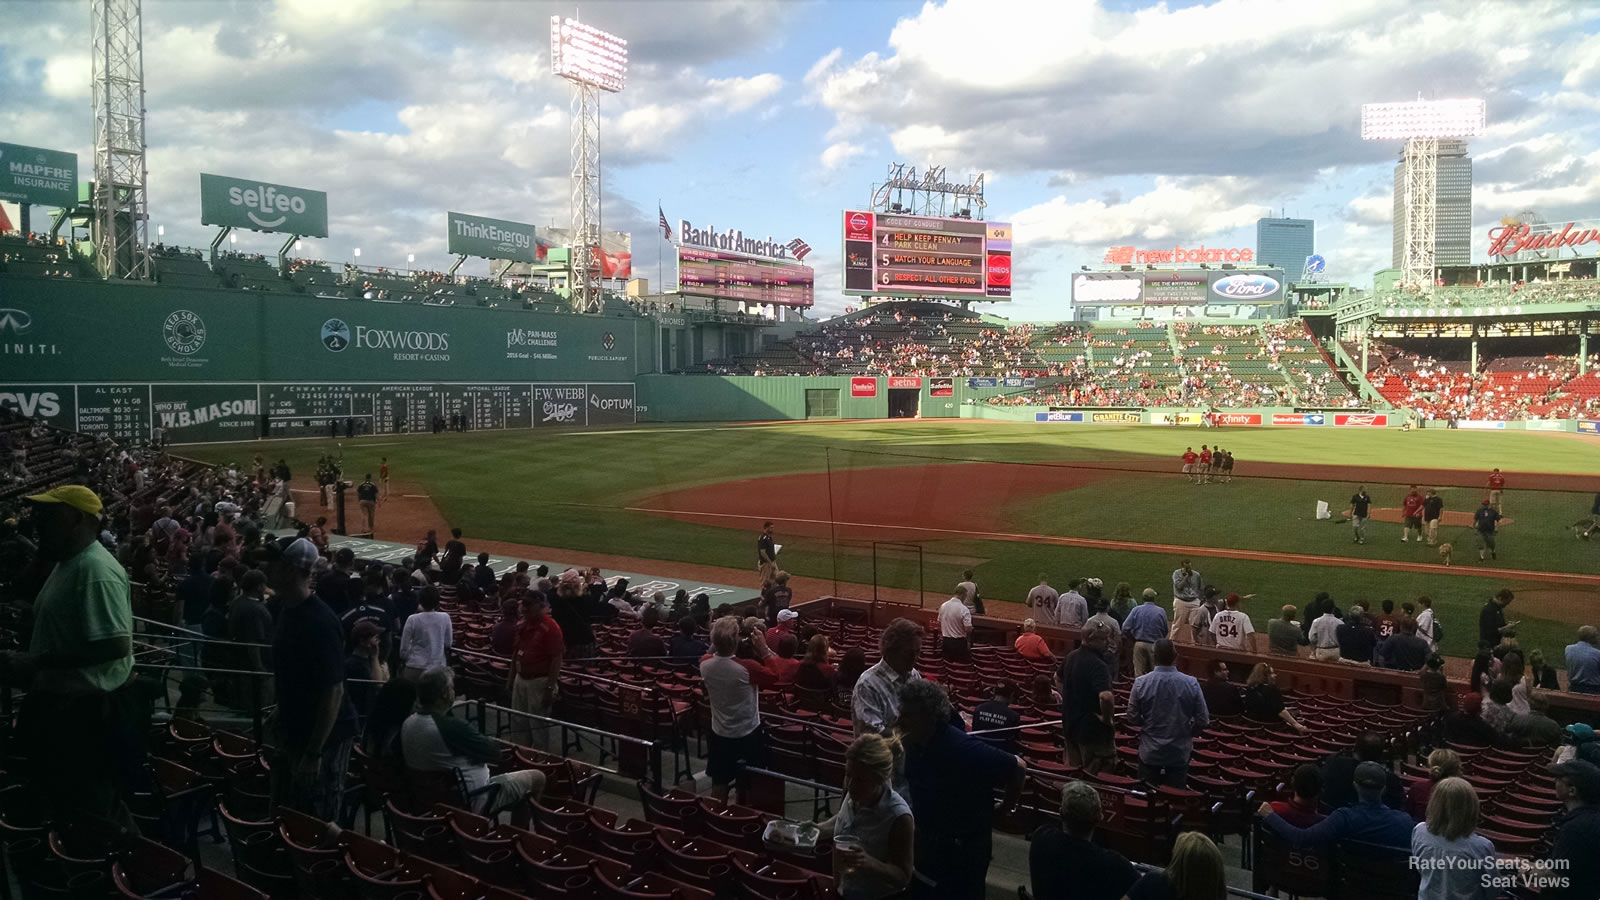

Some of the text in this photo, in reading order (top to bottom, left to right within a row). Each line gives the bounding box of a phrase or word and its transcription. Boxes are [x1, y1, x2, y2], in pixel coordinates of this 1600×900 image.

[9, 161, 73, 180] MAPFRE
[13, 175, 70, 191] INSURANCE
[914, 220, 940, 229] CONDUCT
[454, 219, 530, 249] ThinkEnergy
[681, 219, 786, 259] Bank of America
[882, 232, 961, 246] 4 HELP KEEP FENWAY
[894, 241, 938, 251] PARK CLEAN
[882, 254, 972, 267] 5 WATCH YOUR LANGUAGE
[1137, 249, 1174, 265] new
[1174, 245, 1253, 263] balance
[988, 266, 1010, 274] ENEOS
[882, 272, 890, 284] 6
[894, 273, 922, 282] RESPECT
[939, 276, 959, 284] OTHER
[959, 277, 976, 285] FANS
[1226, 277, 1265, 295] Ford
[165, 311, 198, 331] RED SOX
[167, 328, 204, 353] SCHOLARS
[355, 325, 449, 351] FOXWOODS
[527, 330, 558, 339] PAN-MASS
[527, 338, 558, 347] CHALLENGE
[393, 353, 419, 361] RESORT
[893, 379, 917, 388] aetna
[534, 387, 585, 401] F.W. WEBB
[154, 402, 188, 411] WHO BUT
[600, 399, 633, 410] OPTUM
[1093, 412, 1140, 422] GRANITE CITY
[1222, 415, 1251, 425] xfinity
[79, 423, 109, 431] TORONTO
[1035, 595, 1051, 609] 34
[1219, 624, 1238, 638] 34
[1380, 624, 1394, 637] 34
[623, 701, 639, 714] 59
[1288, 851, 1320, 871] 56
